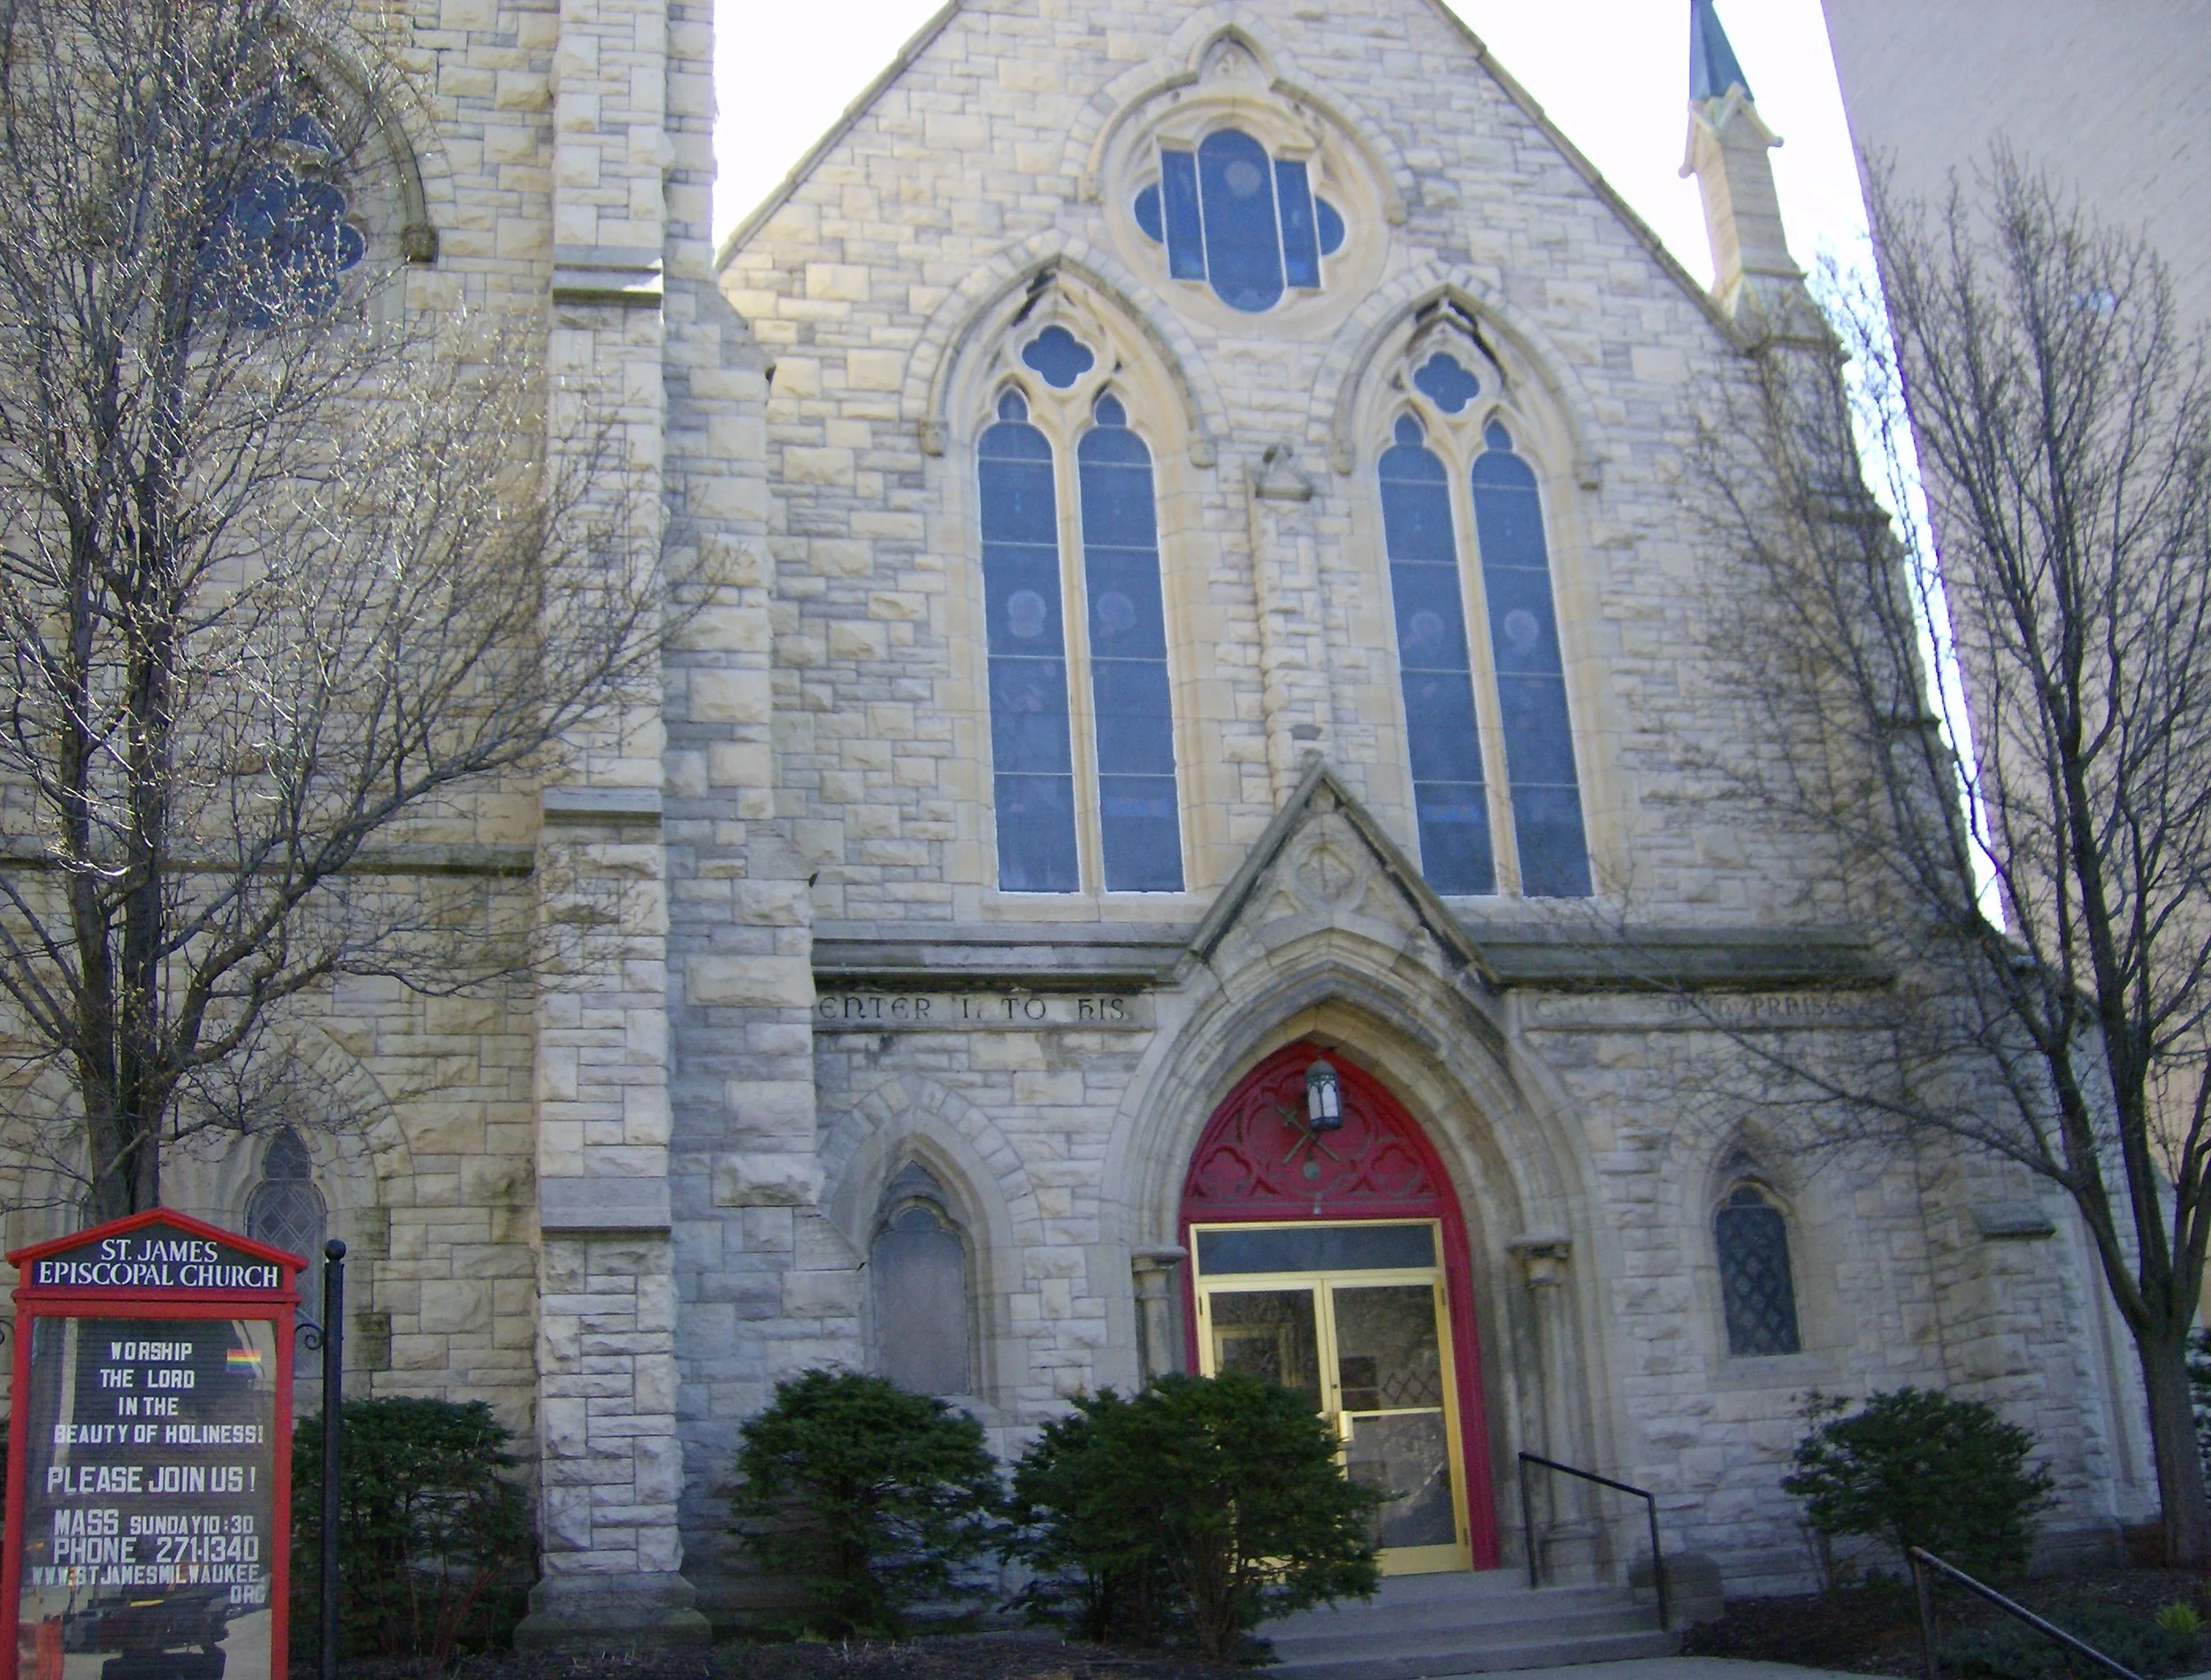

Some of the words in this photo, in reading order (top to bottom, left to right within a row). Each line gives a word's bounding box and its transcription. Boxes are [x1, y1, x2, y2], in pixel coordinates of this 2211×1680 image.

[819, 997, 932, 1020] ENTER
[962, 997, 1047, 1020] ITO
[101, 1239, 132, 1262] ST.
[137, 1241, 218, 1263] JAMES
[39, 1262, 174, 1286] EPISCOPAL
[180, 1264, 279, 1287] CHURCH
[111, 1342, 193, 1361] WORSHIP
[100, 1370, 134, 1388] THE
[147, 1370, 195, 1388] LORD
[119, 1397, 138, 1416] IN
[143, 1397, 180, 1416] THE
[54, 1424, 128, 1444] BEAUTY
[134, 1424, 157, 1444] OF
[165, 1424, 264, 1444] HOLINESS!
[47, 1467, 143, 1493] PLEASE
[149, 1467, 205, 1493] JOIN
[54, 1508, 119, 1536] MASS
[53, 1537, 137, 1564] PHONE
[230, 1585, 266, 1604] ORG
